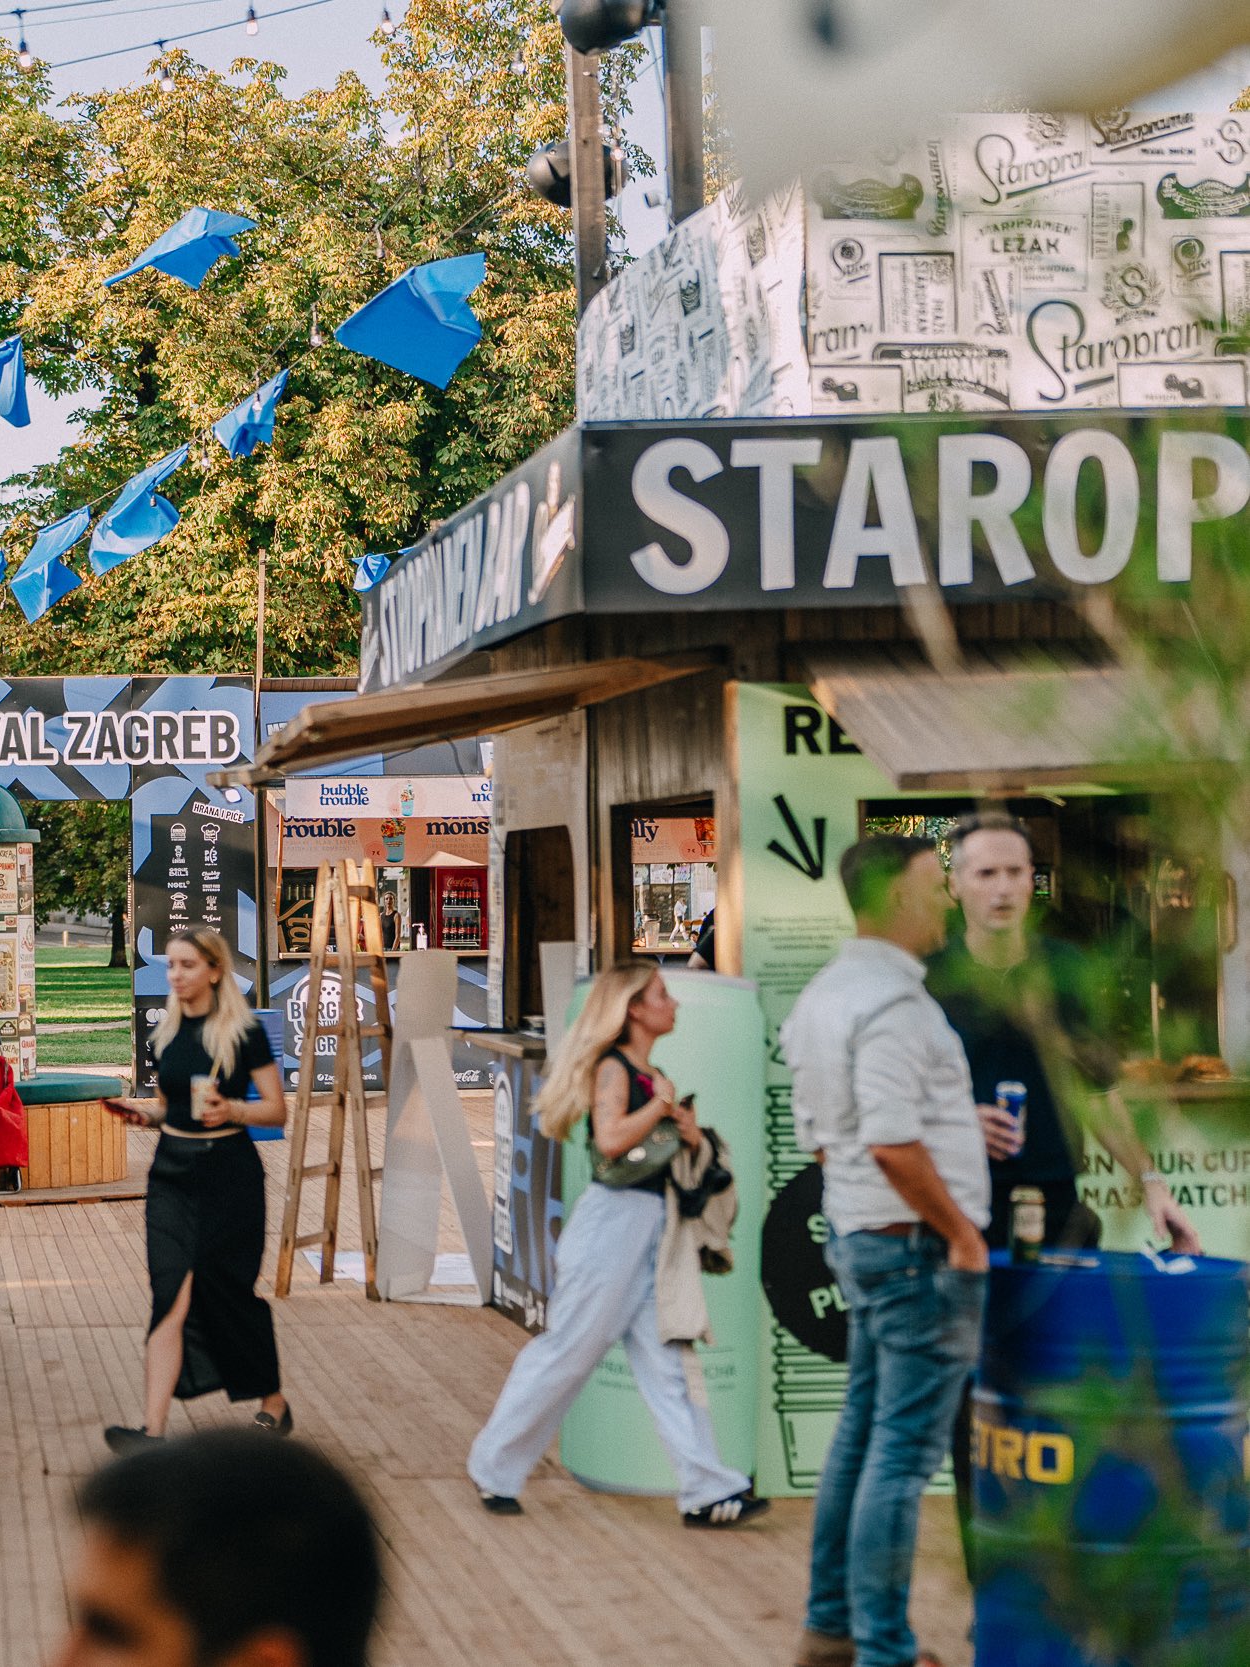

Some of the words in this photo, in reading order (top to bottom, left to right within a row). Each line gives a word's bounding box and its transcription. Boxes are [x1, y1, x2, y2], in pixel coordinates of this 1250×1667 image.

[630, 429, 1250, 594] STAROP
[65, 709, 239, 765] ZAGREB
[320, 784, 368, 796] bubble
[319, 794, 370, 806] trouble
[193, 803, 219, 817] HRANA
